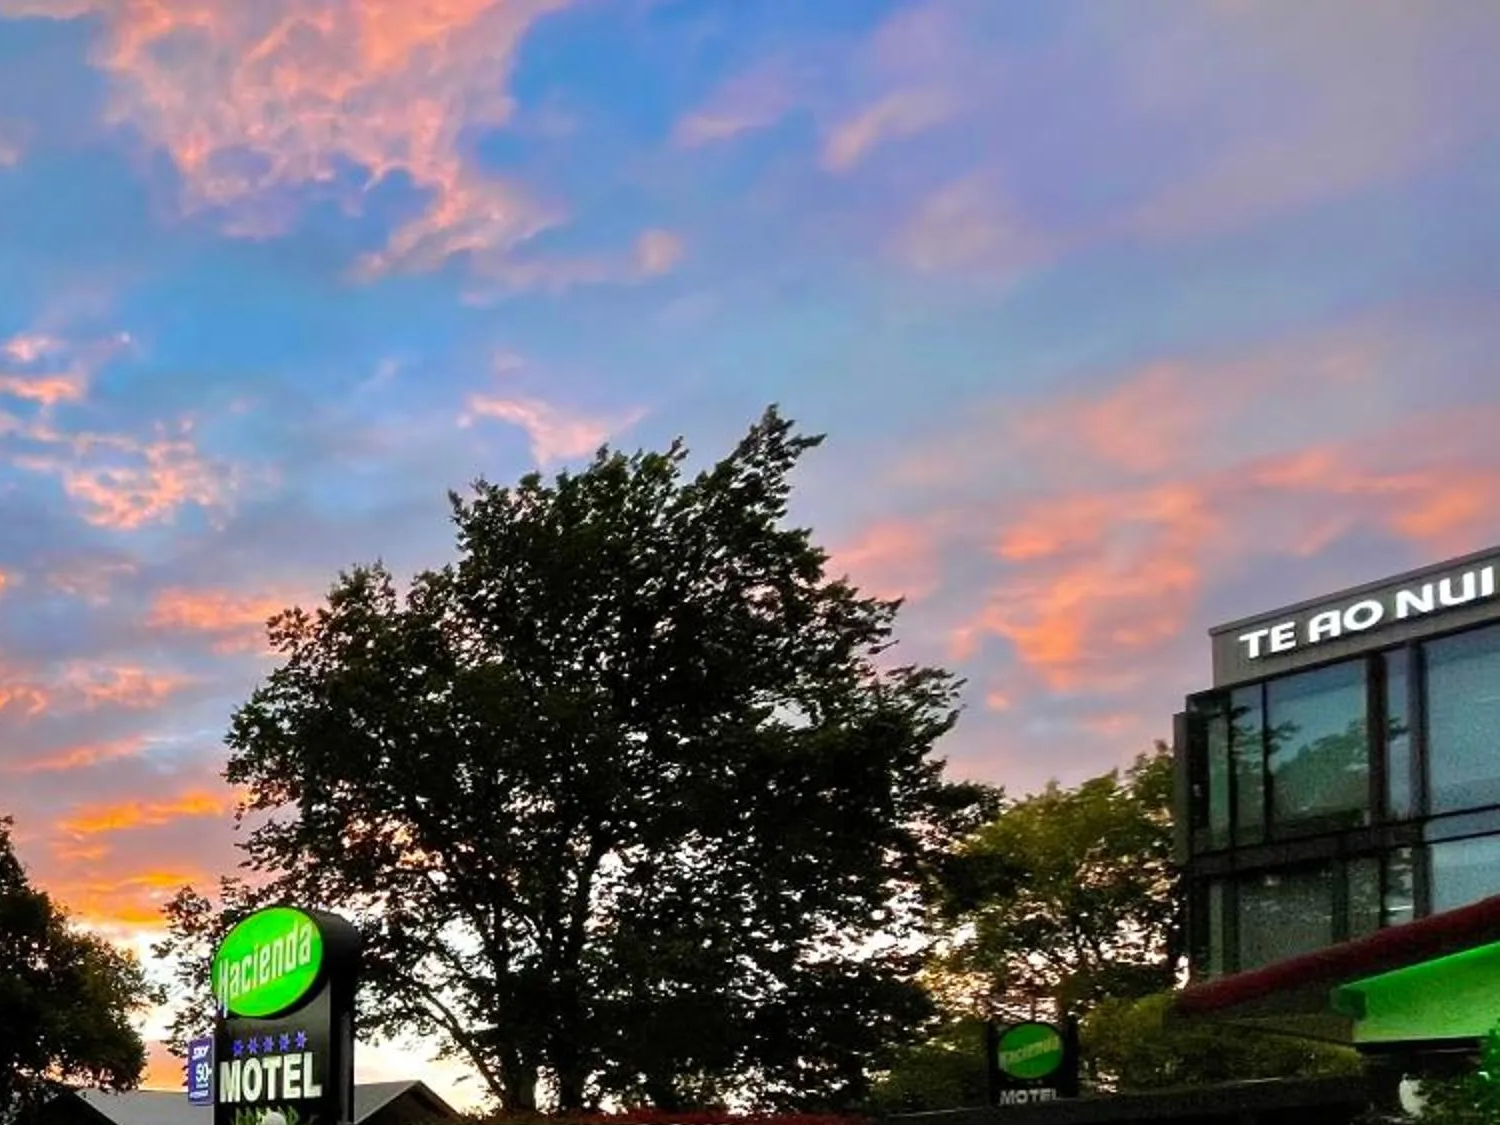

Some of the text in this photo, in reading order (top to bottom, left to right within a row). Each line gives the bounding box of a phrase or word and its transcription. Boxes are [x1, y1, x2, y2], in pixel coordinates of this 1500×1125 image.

[1239, 566, 1495, 659] TE AO NUI
[218, 919, 313, 1019] Hacienda
[219, 1052, 323, 1103] MOTEL
[1000, 1088, 1059, 1105] MOTEL
